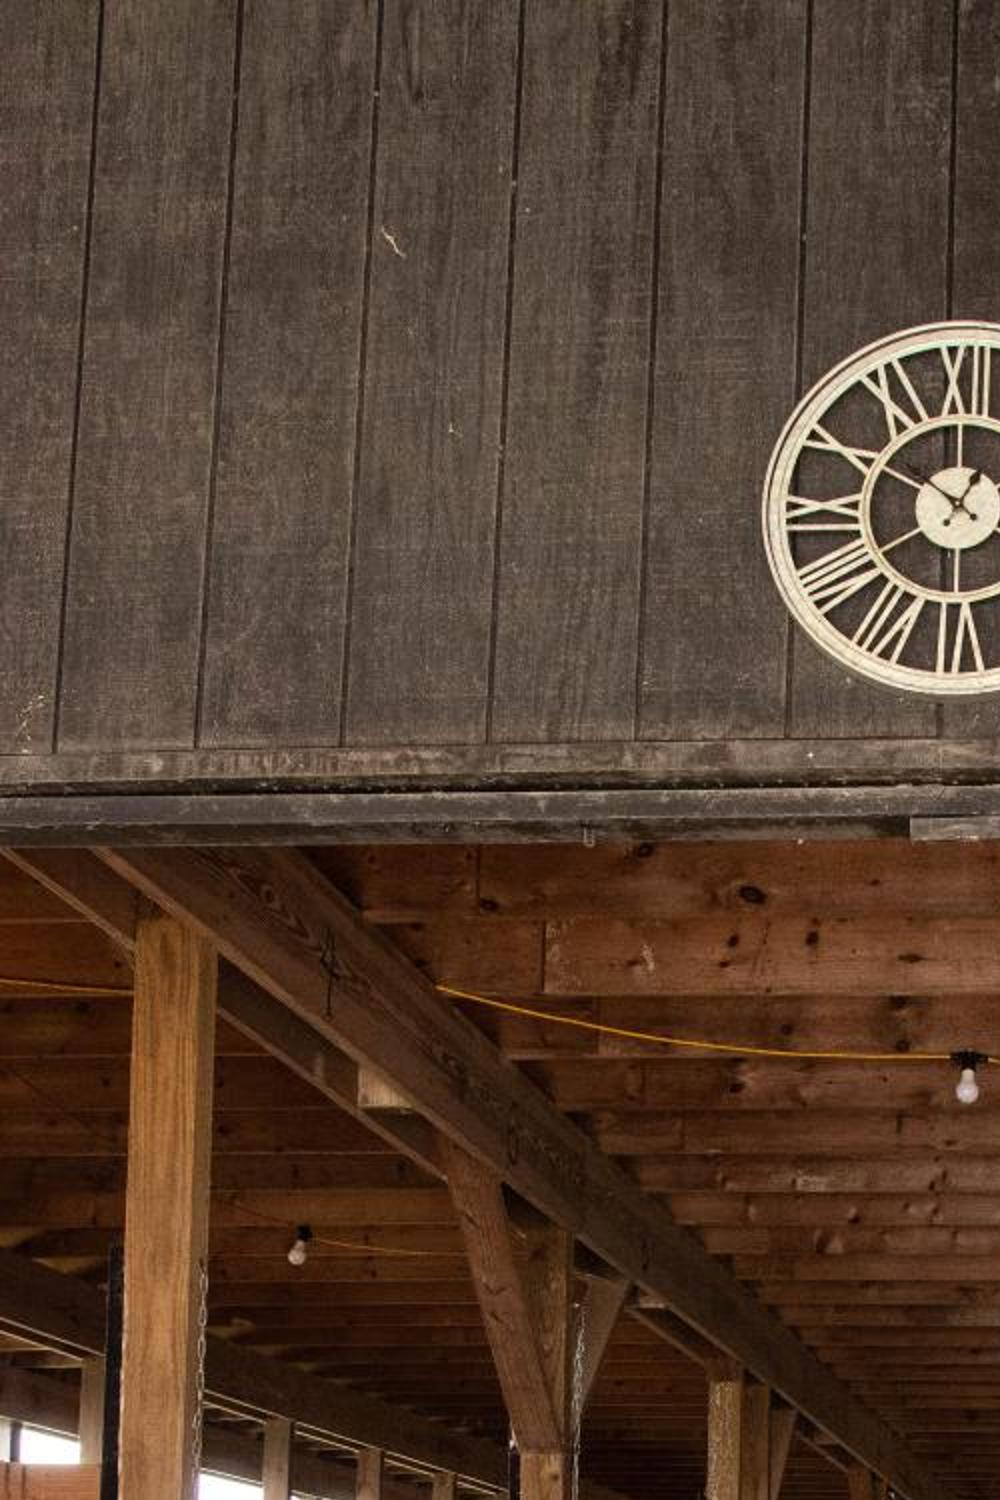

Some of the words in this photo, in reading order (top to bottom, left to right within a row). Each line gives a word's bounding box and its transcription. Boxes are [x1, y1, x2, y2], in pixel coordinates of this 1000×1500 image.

[860, 359, 929, 440] XI
[941, 345, 991, 418] XII
[803, 423, 881, 476] X
[786, 493, 862, 531] IX
[936, 601, 985, 674] VI
